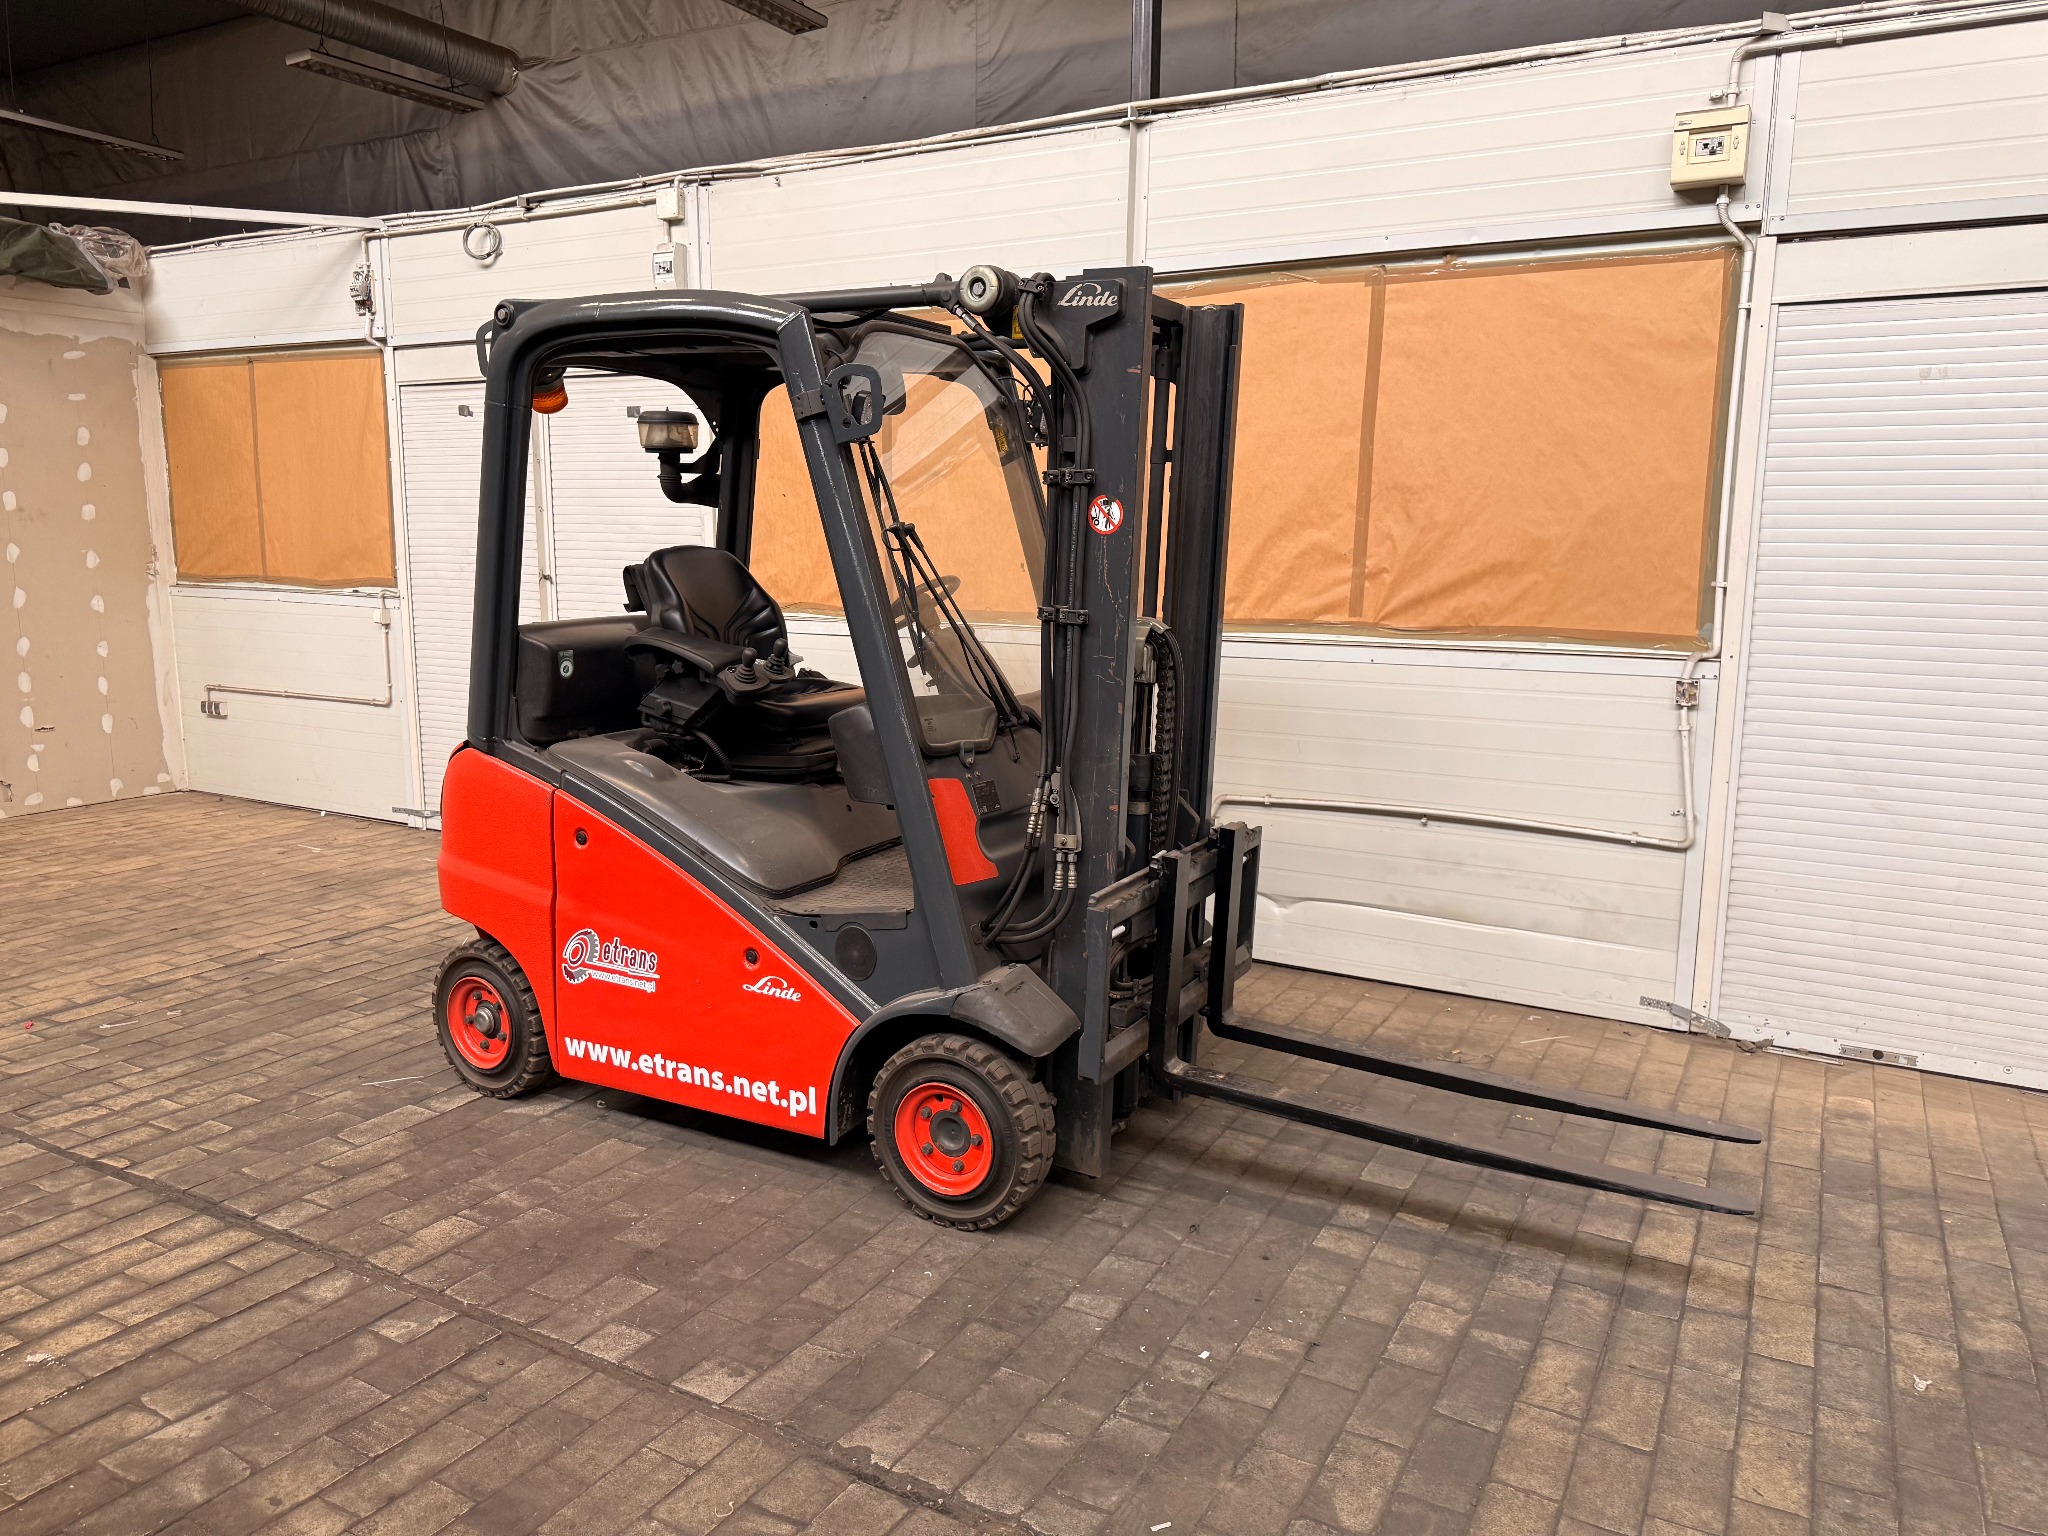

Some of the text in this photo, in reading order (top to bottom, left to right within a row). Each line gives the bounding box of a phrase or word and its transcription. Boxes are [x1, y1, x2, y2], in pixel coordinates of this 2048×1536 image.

[1057, 282, 1118, 307] Linde
[602, 937, 658, 972] etrans
[591, 970, 656, 993] www.etrans.net.pl
[742, 975, 802, 1002] Linde
[564, 1036, 817, 1117] www.etrans.net.pl
